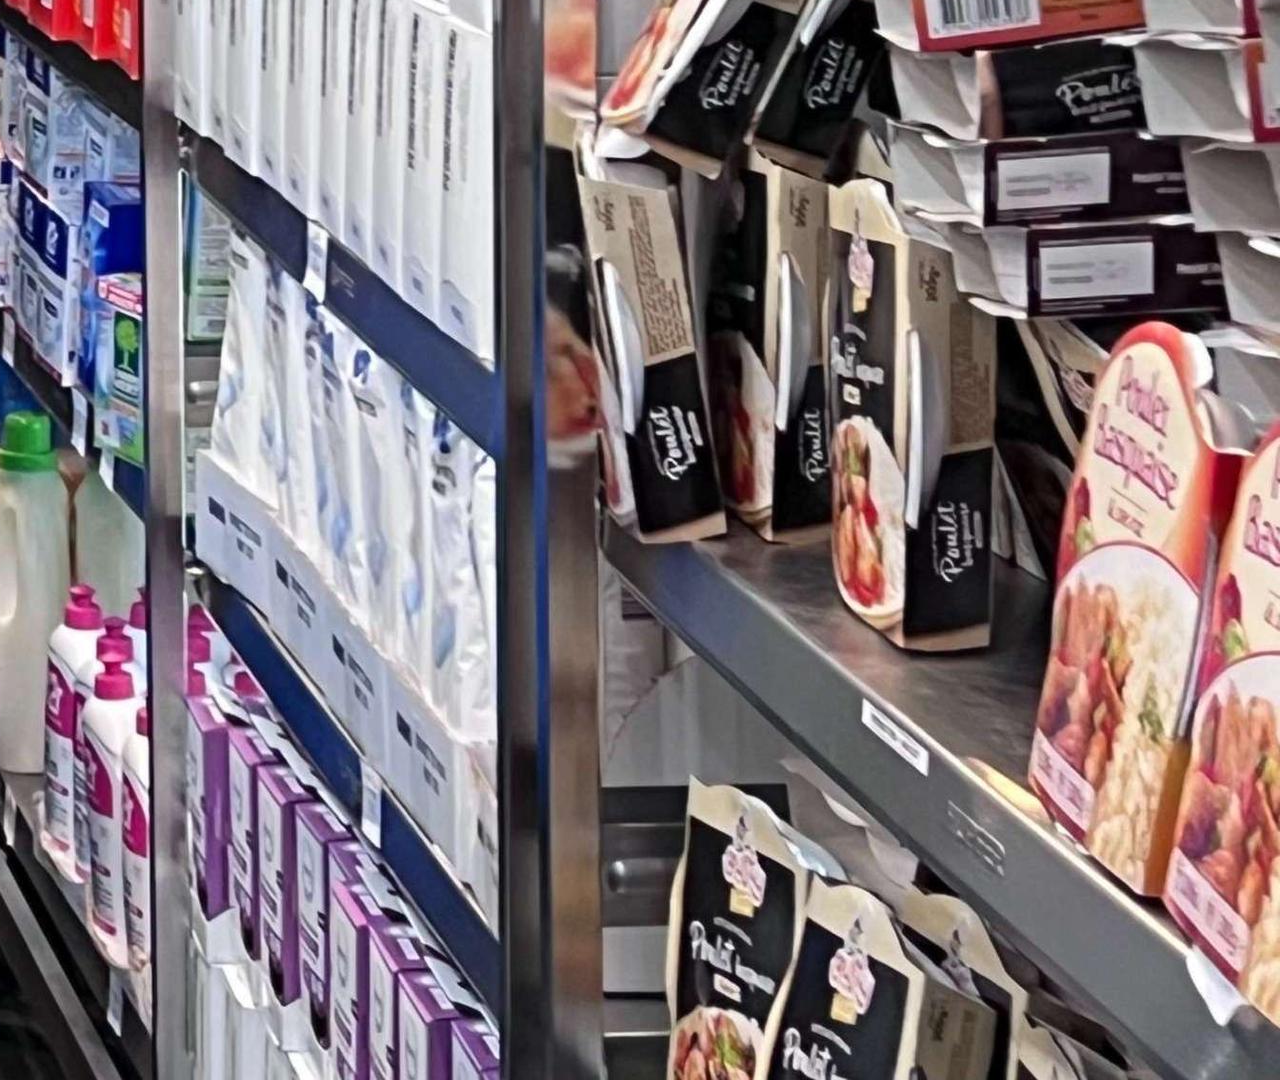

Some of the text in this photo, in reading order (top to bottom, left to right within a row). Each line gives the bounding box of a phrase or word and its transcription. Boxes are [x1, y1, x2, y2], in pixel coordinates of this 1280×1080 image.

[700, 40, 745, 110] Poulet
[807, 38, 845, 110] Poulet
[649, 406, 689, 480] Poulet
[803, 406, 827, 482] Poulet
[937, 500, 964, 582] Poulet
